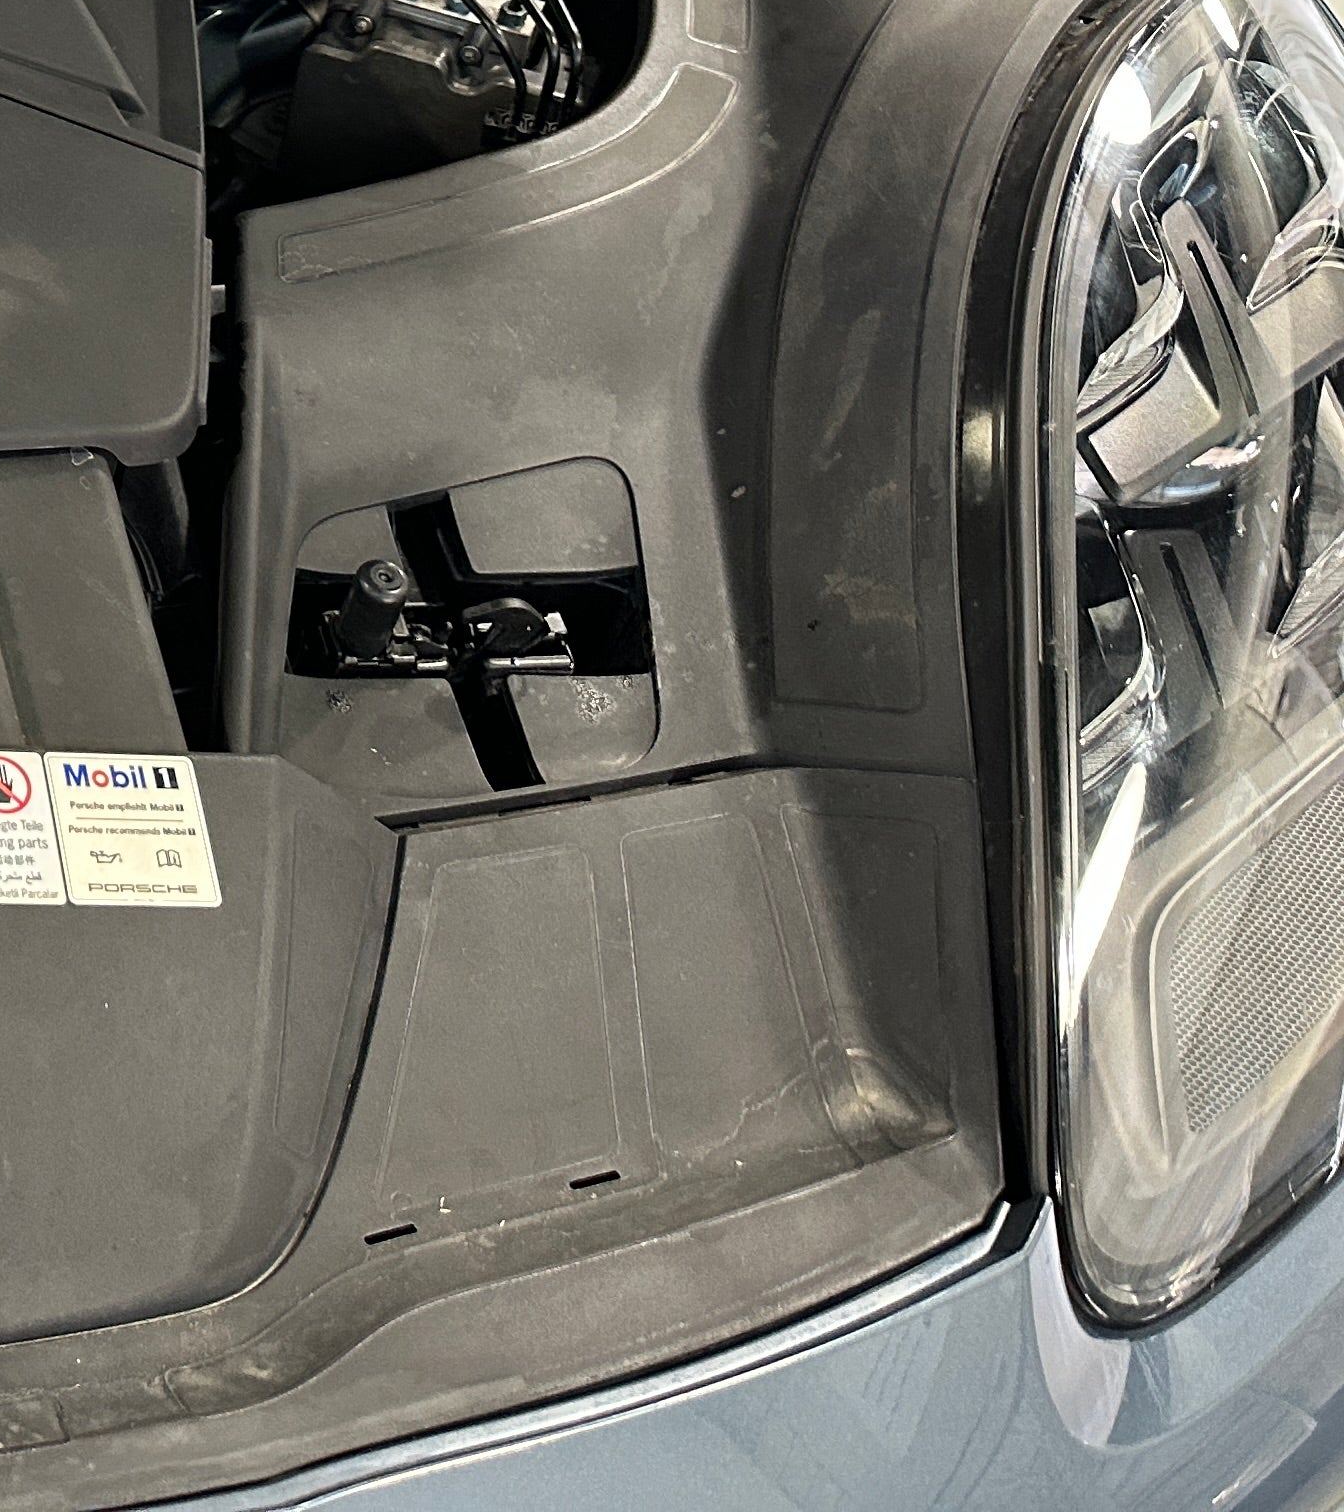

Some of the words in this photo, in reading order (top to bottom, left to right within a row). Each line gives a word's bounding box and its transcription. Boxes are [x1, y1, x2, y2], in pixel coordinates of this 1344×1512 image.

[63, 763, 148, 789] Mobil
[155, 766, 175, 789] 1
[69, 800, 105, 810] Porsche
[107, 802, 147, 812] empfiehlt
[149, 803, 175, 812] Mobil
[20, 819, 44, 832] Teile
[68, 825, 103, 834] Porsche
[105, 827, 161, 836] recommends
[162, 827, 187, 836] Mobil
[18, 837, 49, 850] parts
[88, 883, 198, 894] PORSCHE
